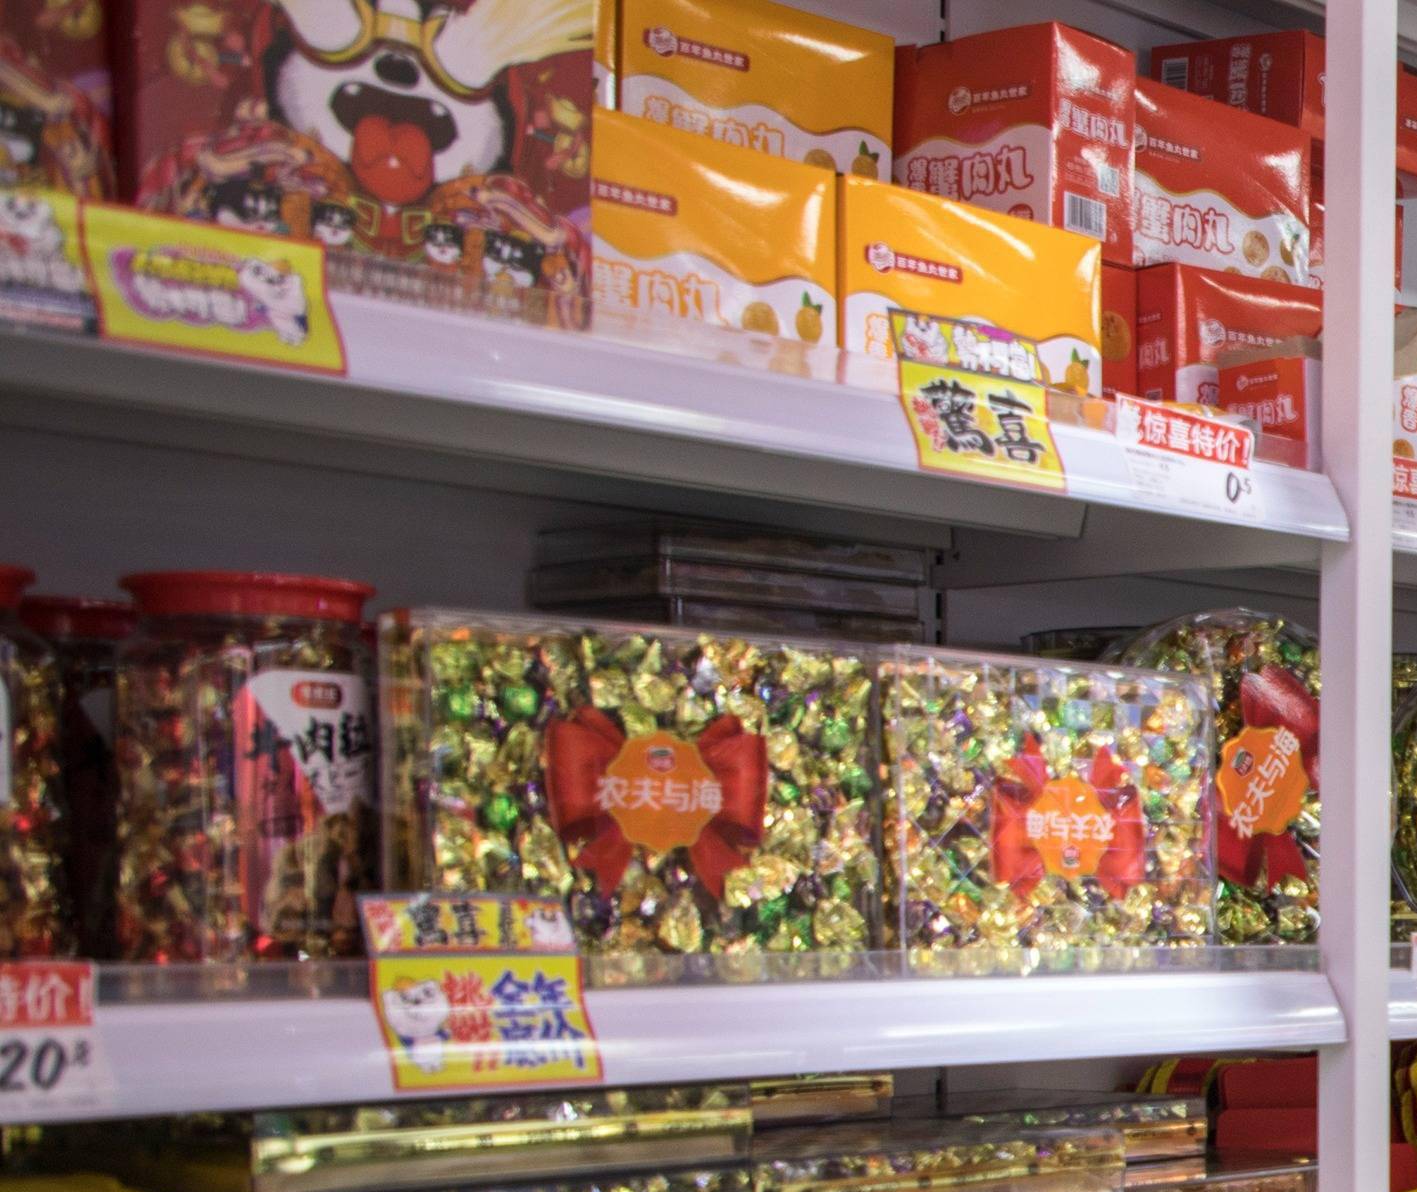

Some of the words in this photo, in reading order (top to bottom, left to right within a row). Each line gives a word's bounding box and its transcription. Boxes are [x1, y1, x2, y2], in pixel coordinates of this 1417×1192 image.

[920, 379, 1047, 464] 驚喜
[1145, 411, 1253, 469] 惊喜特价!
[592, 770, 728, 822] 农夫与海
[1229, 725, 1300, 839] 农夫与海
